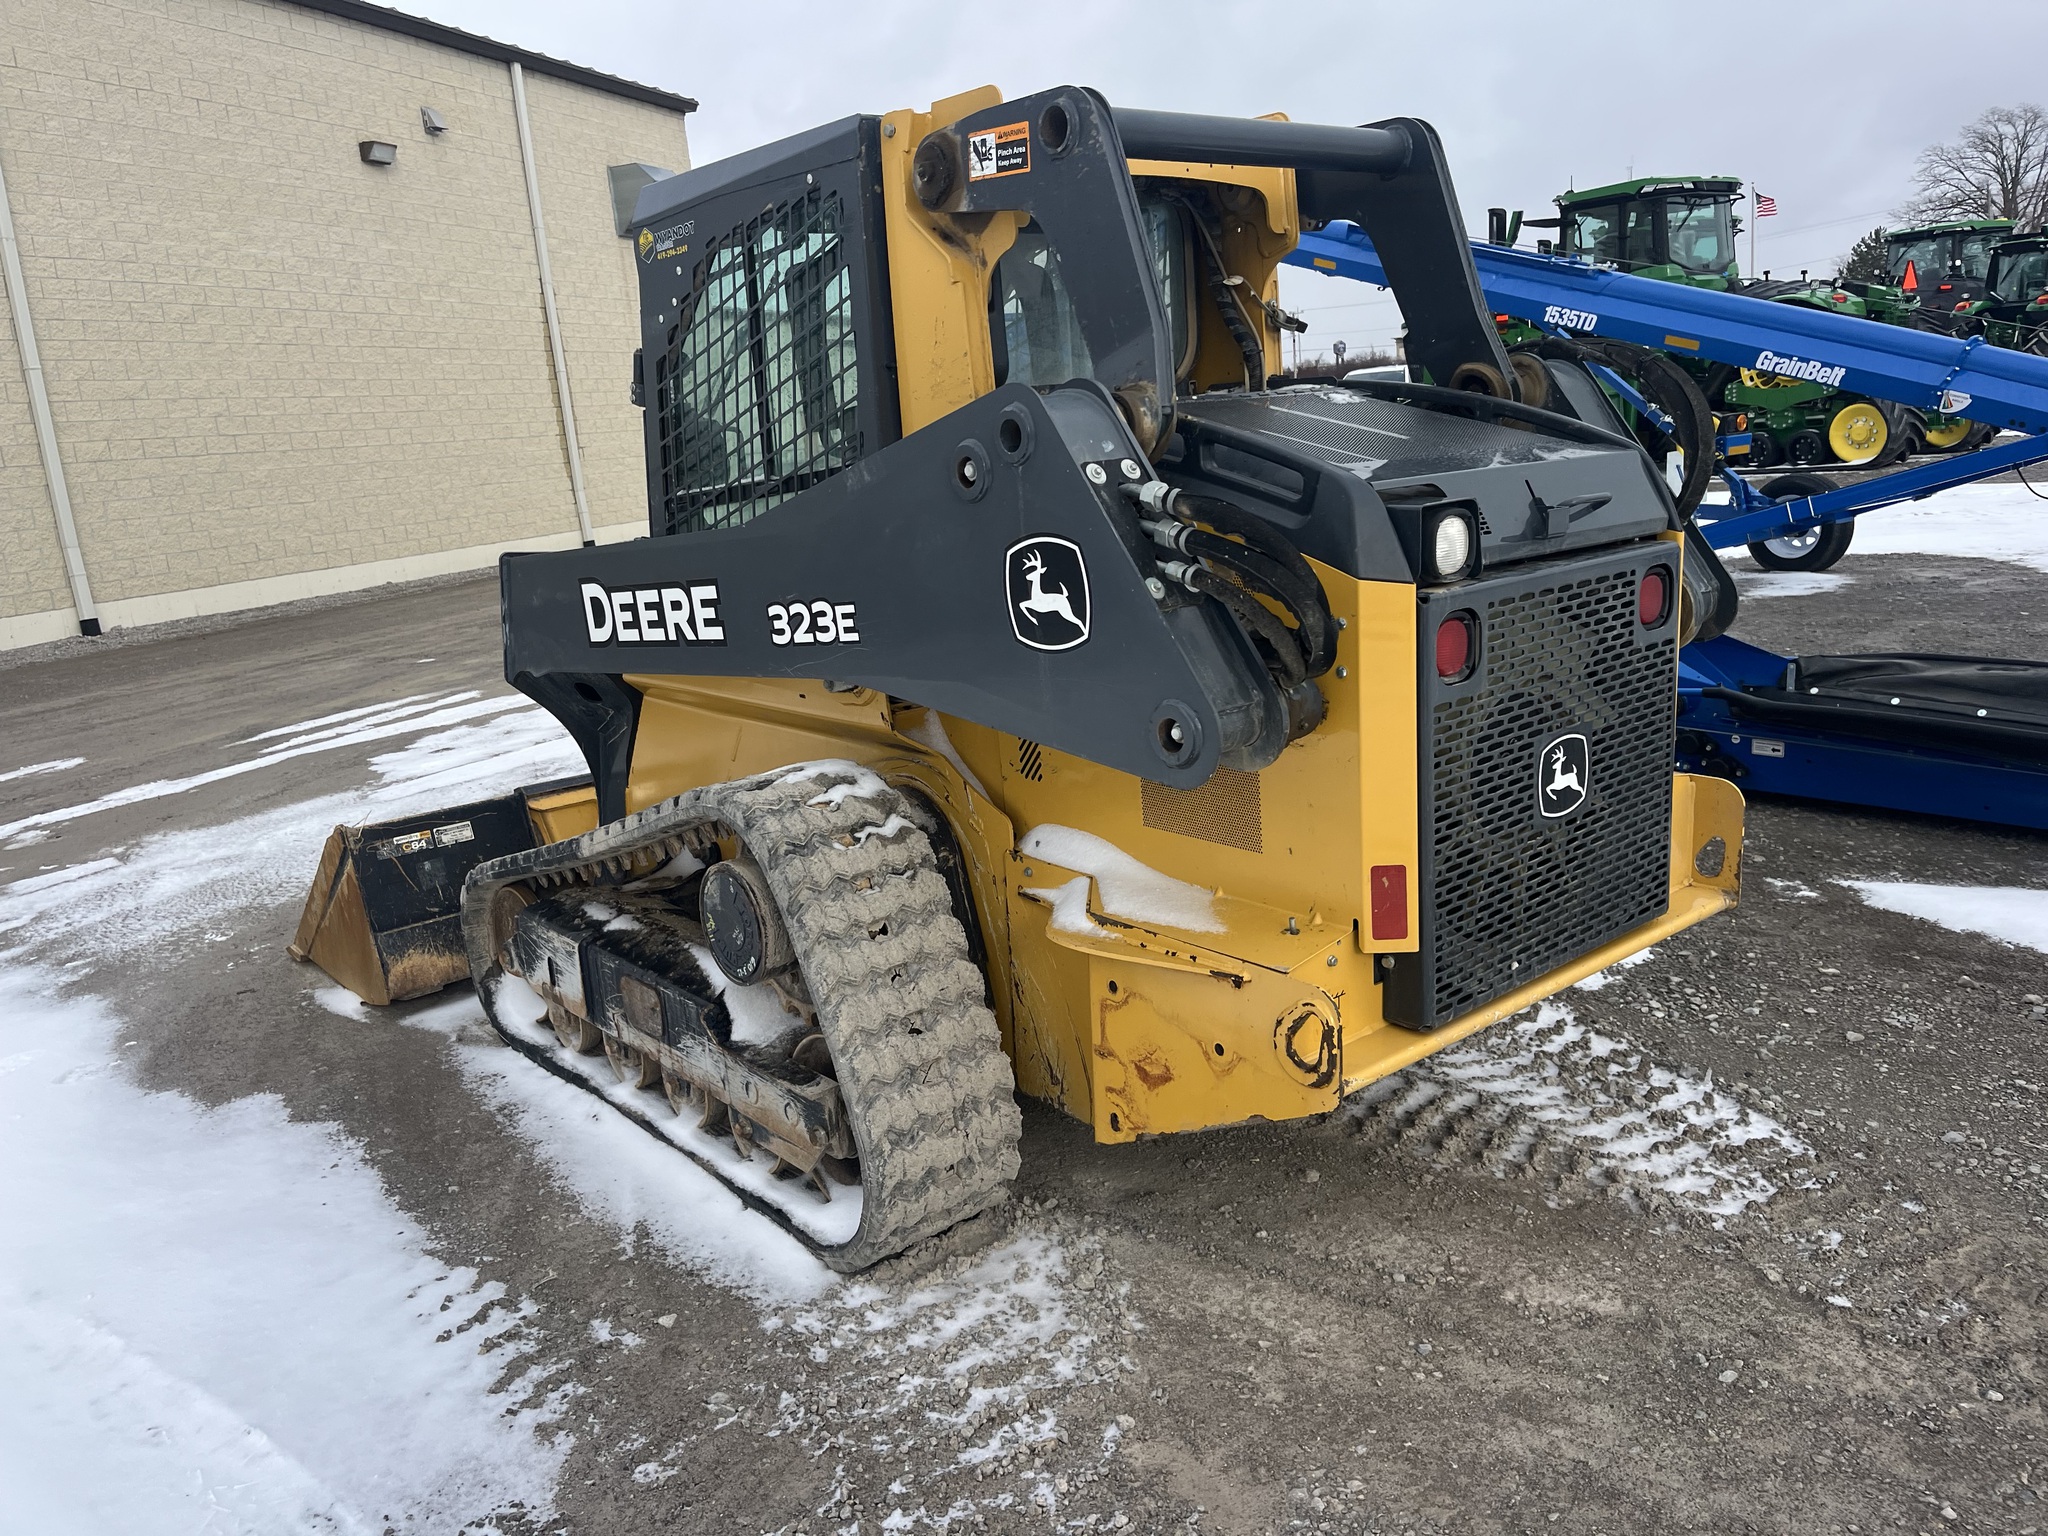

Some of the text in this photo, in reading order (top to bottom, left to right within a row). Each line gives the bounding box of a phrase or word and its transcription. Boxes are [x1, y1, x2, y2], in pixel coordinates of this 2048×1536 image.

[1002, 127, 1026, 138] WARNING
[997, 146, 1026, 158] Pinch Area
[998, 157, 1023, 168] Keep Away
[654, 220, 694, 244] WYANDOT
[1543, 305, 1598, 332] 1535TD
[1755, 350, 1846, 387] GrainBelt
[580, 582, 860, 645] DEERE 323E
[402, 839, 427, 852] C84
